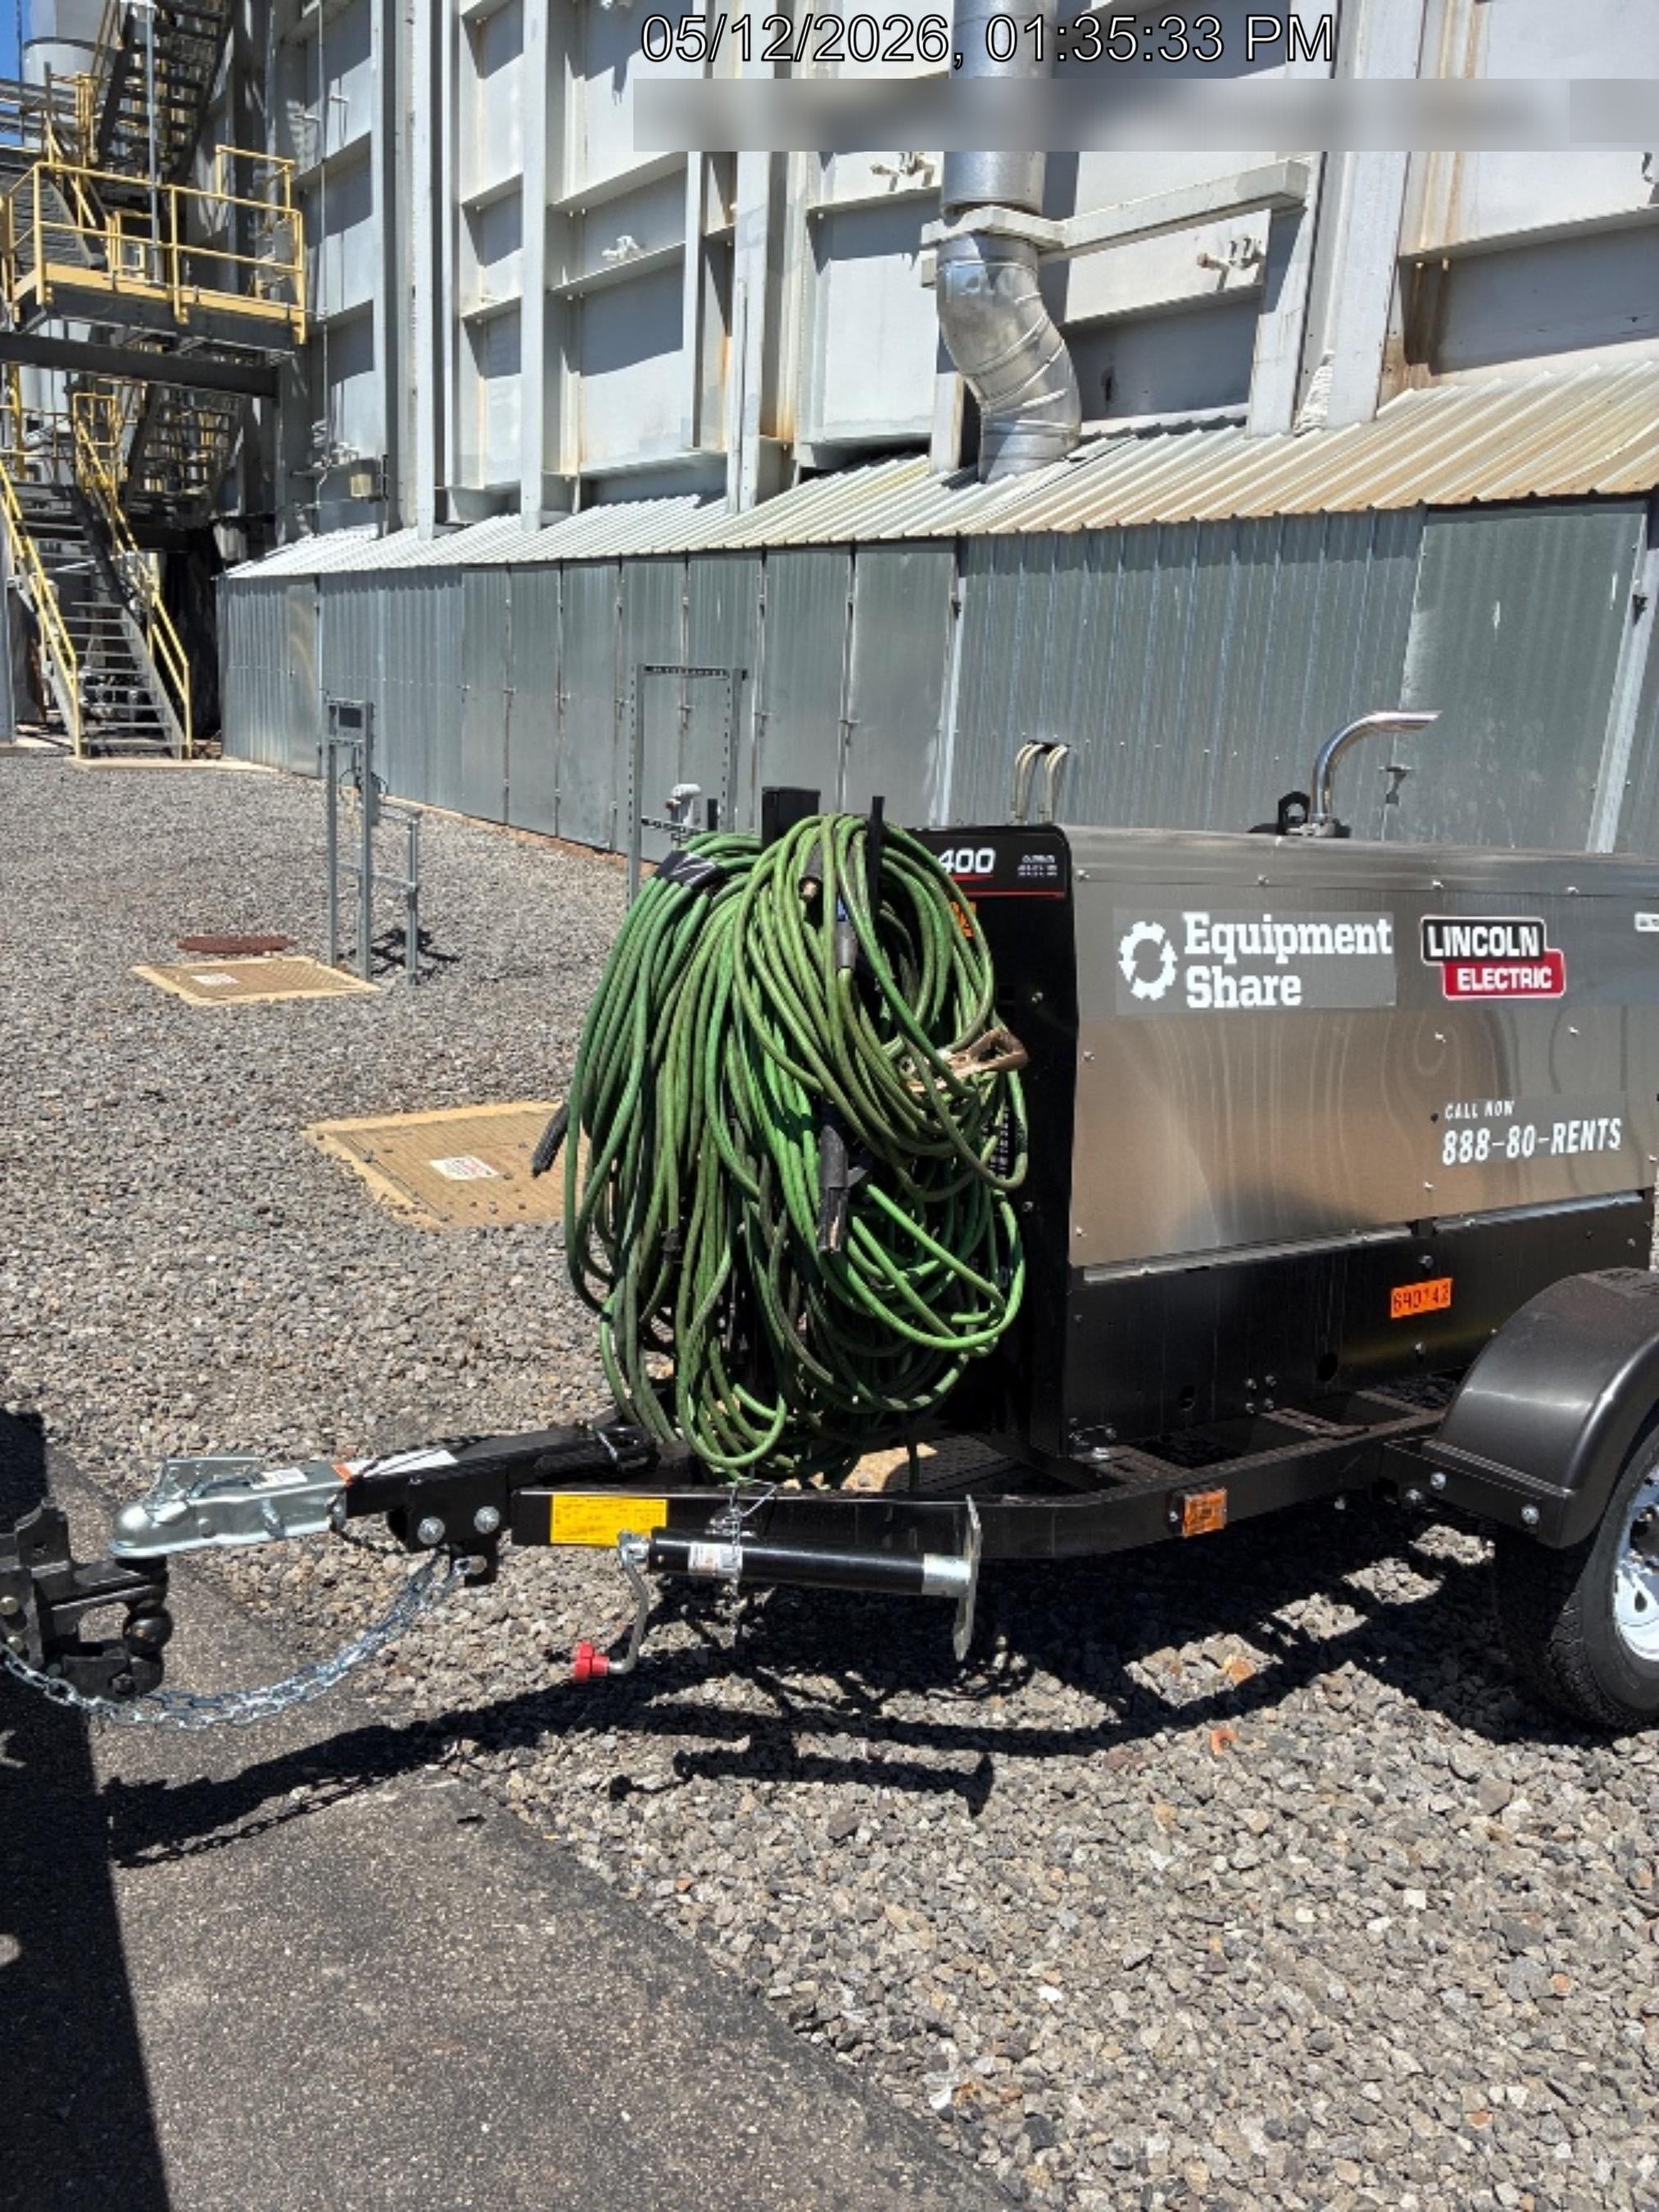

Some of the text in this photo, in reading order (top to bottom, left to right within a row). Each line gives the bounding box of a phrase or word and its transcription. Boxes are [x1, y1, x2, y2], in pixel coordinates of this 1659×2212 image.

[938, 847, 995, 873] 400
[1181, 912, 1392, 964] Equipment
[1427, 926, 1540, 957] LINCOLN
[1185, 965, 1303, 1009] Share
[1456, 968, 1552, 991] ELECTRIC
[1445, 1102, 1478, 1120] CALL
[1442, 1117, 1622, 1166] 888-80-RENTS
